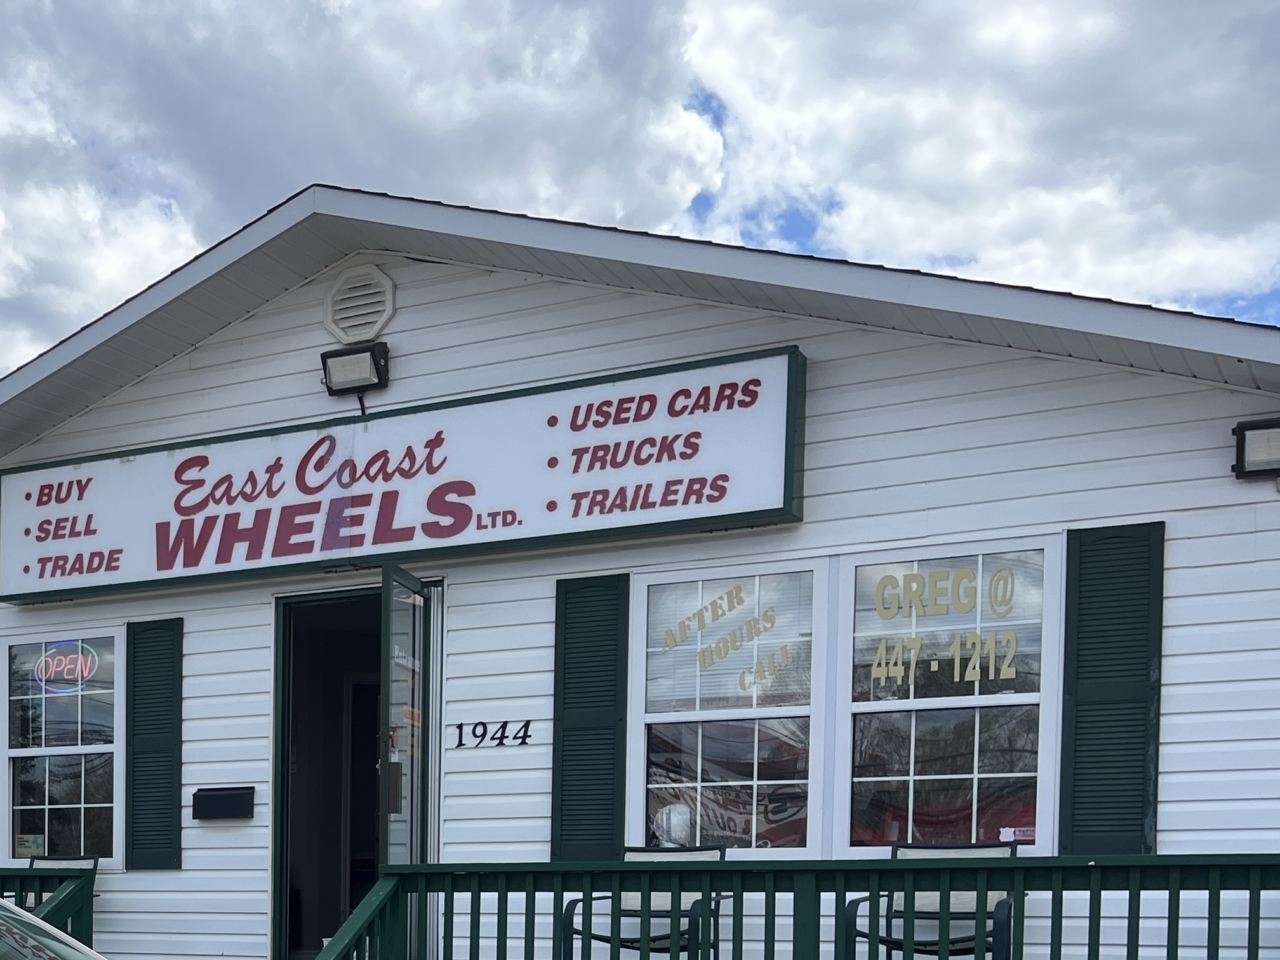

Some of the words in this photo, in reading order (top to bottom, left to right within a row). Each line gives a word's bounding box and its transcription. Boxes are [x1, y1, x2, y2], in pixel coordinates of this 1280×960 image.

[569, 393, 658, 432] USED
[667, 378, 762, 418] CARS
[173, 454, 286, 517] East
[295, 430, 448, 496] Coast
[571, 430, 702, 474] TRUCKS
[35, 477, 94, 507] BUY
[570, 473, 730, 518] TRAILERS
[35, 513, 98, 543] SELL
[155, 480, 476, 571] WHEELS
[476, 509, 523, 531] LTD.
[36, 548, 124, 579] TRADE
[875, 567, 977, 621] GREG
[988, 564, 1015, 618] @
[660, 585, 745, 655] AFTER
[697, 606, 777, 672] HOURS
[38, 653, 93, 681] OPEN
[737, 644, 795, 692] CALL
[455, 719, 532, 748] 1944
